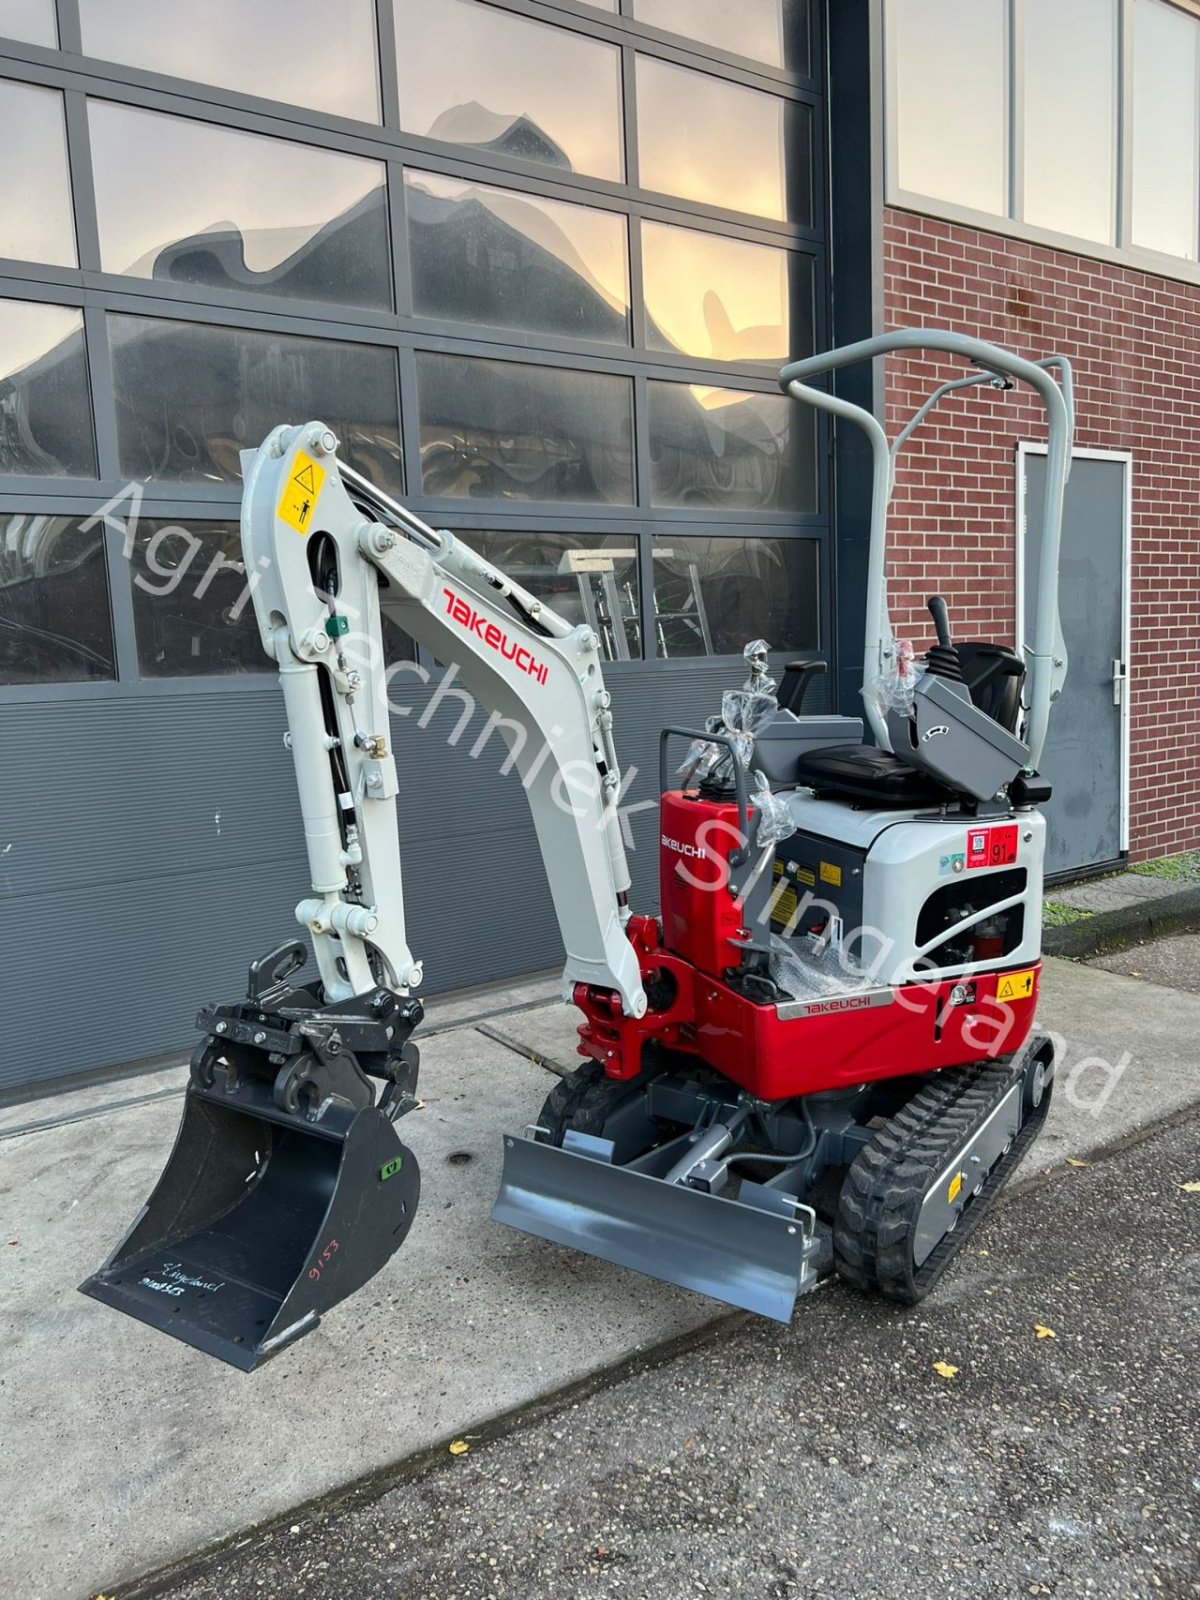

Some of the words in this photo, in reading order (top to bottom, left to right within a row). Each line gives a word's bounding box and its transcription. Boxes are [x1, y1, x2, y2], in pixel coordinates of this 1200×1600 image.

[443, 587, 549, 686] TAKEUCHI
[661, 834, 706, 859] AKEUCHI
[992, 843, 1007, 864] 91
[803, 996, 871, 1015] TAKEUCHI
[308, 1239, 339, 1281] 9153
